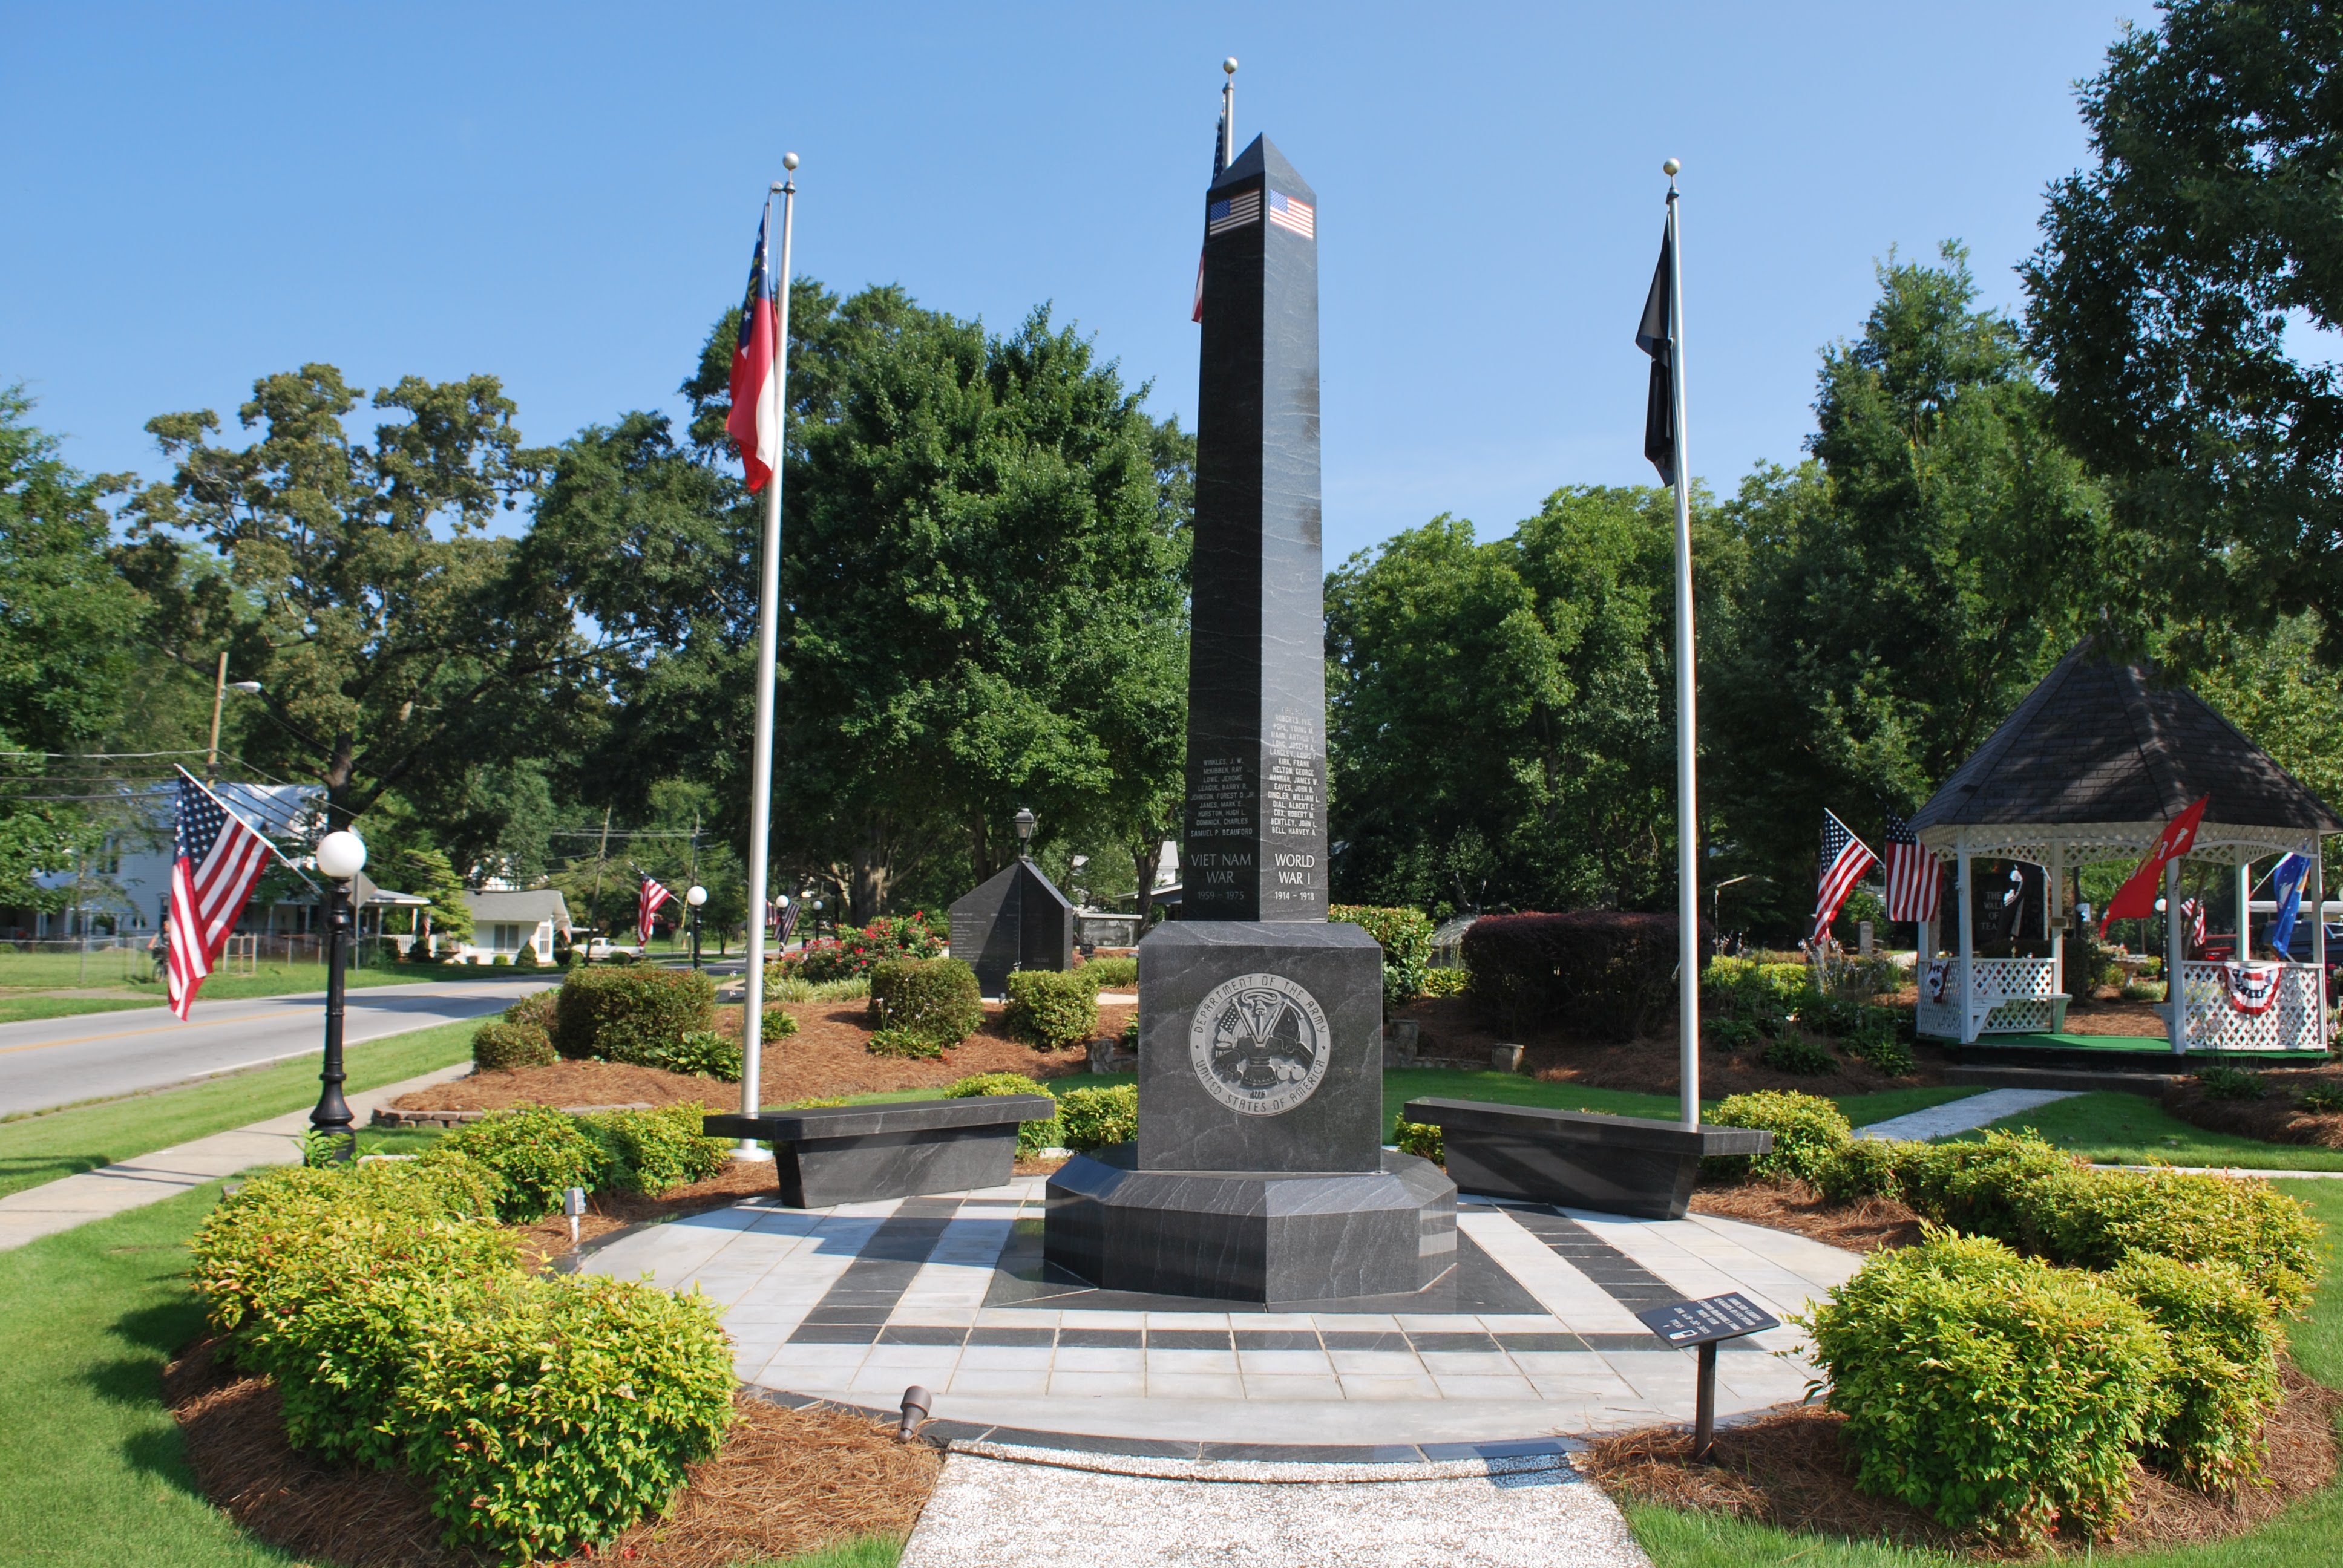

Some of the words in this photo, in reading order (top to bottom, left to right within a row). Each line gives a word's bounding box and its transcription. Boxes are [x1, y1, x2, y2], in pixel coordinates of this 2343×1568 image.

[1270, 748, 1295, 758] LANGLEY,
[1273, 766, 1293, 774] HELTON,
[1296, 768, 1314, 777] GEORGE
[1270, 774, 1291, 783] HANNAH,
[1274, 783, 1293, 792] EAVES,
[1273, 800, 1286, 809] DIAL,
[1274, 808, 1286, 817] COX,
[1271, 818, 1297, 827] BENTLEY,
[1272, 826, 1287, 835] BELL,
[1191, 854, 1217, 866] VIET
[1222, 854, 1251, 866] NAM
[1274, 853, 1315, 867] WORLD
[1206, 871, 1234, 883] WAR
[1279, 871, 1303, 884] WAR
[1308, 872, 1311, 884] I
[1197, 891, 1215, 900] 1959
[1226, 891, 1244, 900] 1975
[1275, 891, 1290, 900] 1914
[1300, 892, 1315, 900] 1918
[1980, 922, 1997, 930] TEA
[1194, 977, 1252, 1033] DEPARTMENT
[1262, 976, 1276, 986] OF
[1283, 982, 1304, 999] THE
[1306, 1001, 1327, 1033] ARMY
[1196, 1060, 1221, 1094] UNITED
[1225, 1095, 1266, 1112] STATES
[1273, 1099, 1284, 1109] OF
[1290, 1060, 1325, 1103] AMERICA
